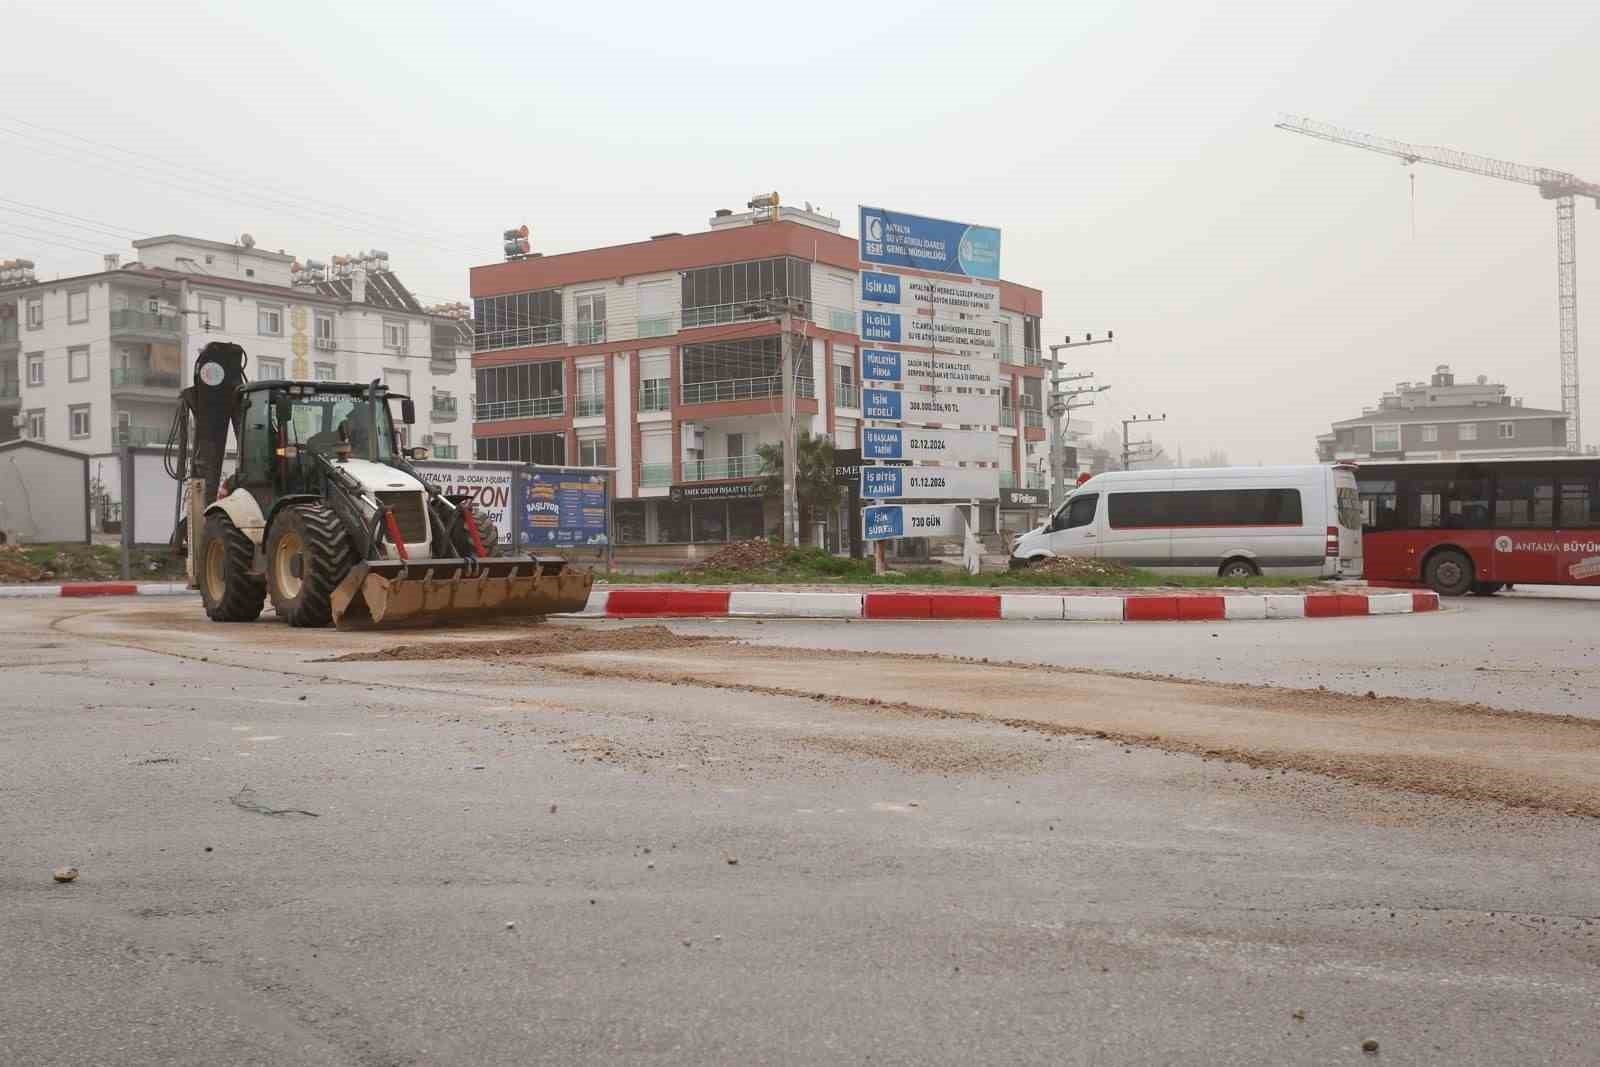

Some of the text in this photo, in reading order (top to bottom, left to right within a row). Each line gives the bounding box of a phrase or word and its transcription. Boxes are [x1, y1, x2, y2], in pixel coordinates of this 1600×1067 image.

[835, 465, 862, 475] EME
[912, 513, 941, 527] 730 GÜN
[1513, 542, 1560, 552] ANTALYA
